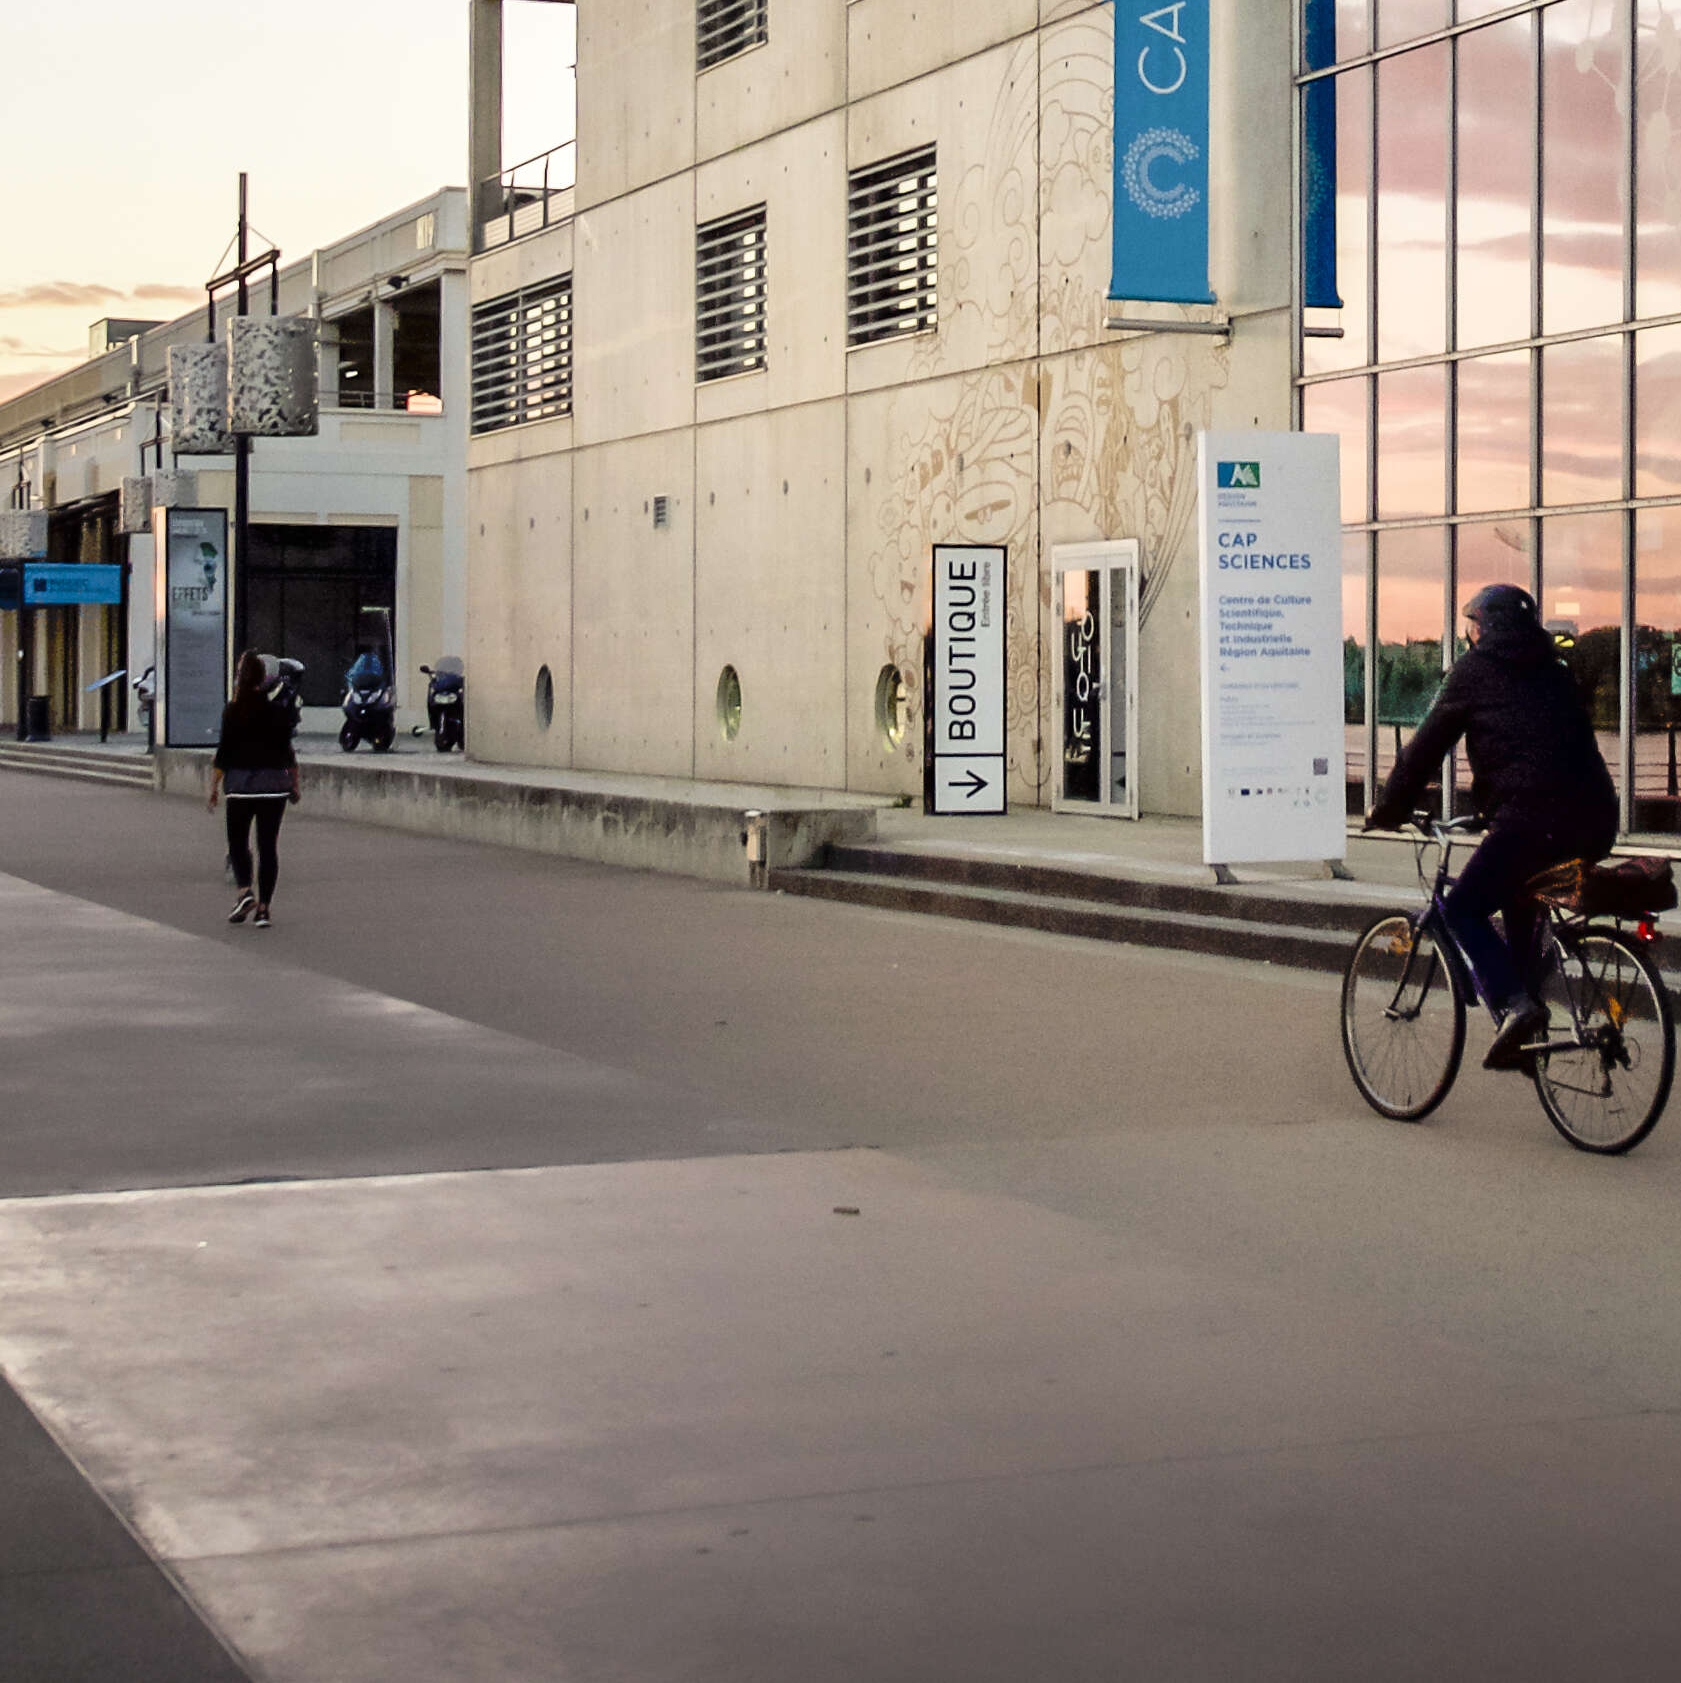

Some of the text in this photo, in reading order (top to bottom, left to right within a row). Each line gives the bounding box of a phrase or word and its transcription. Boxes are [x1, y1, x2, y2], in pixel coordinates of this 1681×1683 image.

[1218, 532, 1258, 548] CAP
[1218, 554, 1311, 570] SCIENCES
[1219, 594, 1312, 605] Centre de Culture
[1219, 621, 1273, 632] Technique
[1220, 635, 1230, 644] et
[948, 561, 976, 740] BOUTIQUE
[1220, 647, 1311, 659] Région Aquitaine
